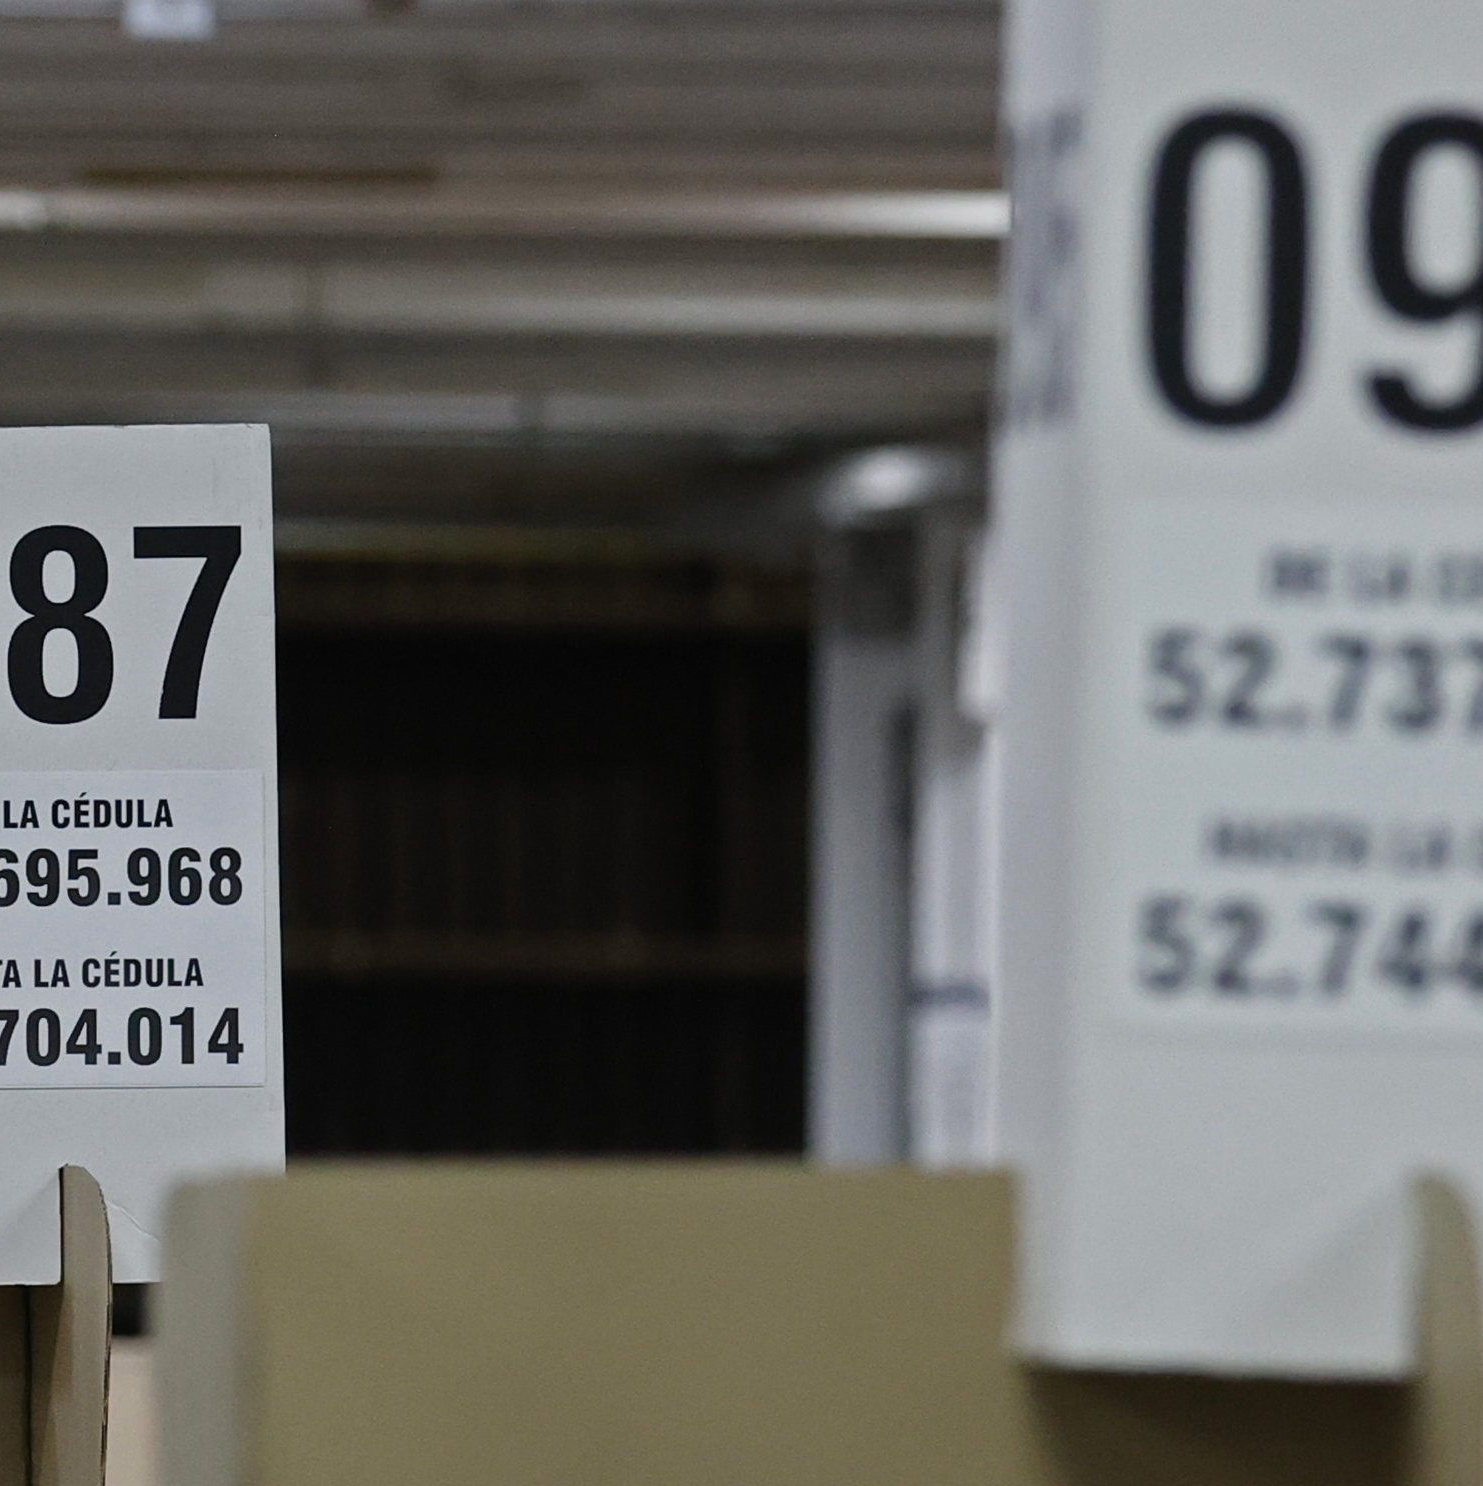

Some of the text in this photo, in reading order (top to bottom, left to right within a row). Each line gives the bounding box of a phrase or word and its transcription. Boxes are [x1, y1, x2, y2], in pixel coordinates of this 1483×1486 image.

[3, 800, 40, 829] LA
[51, 791, 174, 829] CÉDULA
[34, 958, 70, 988] LA
[81, 950, 204, 988] CÉDULA
